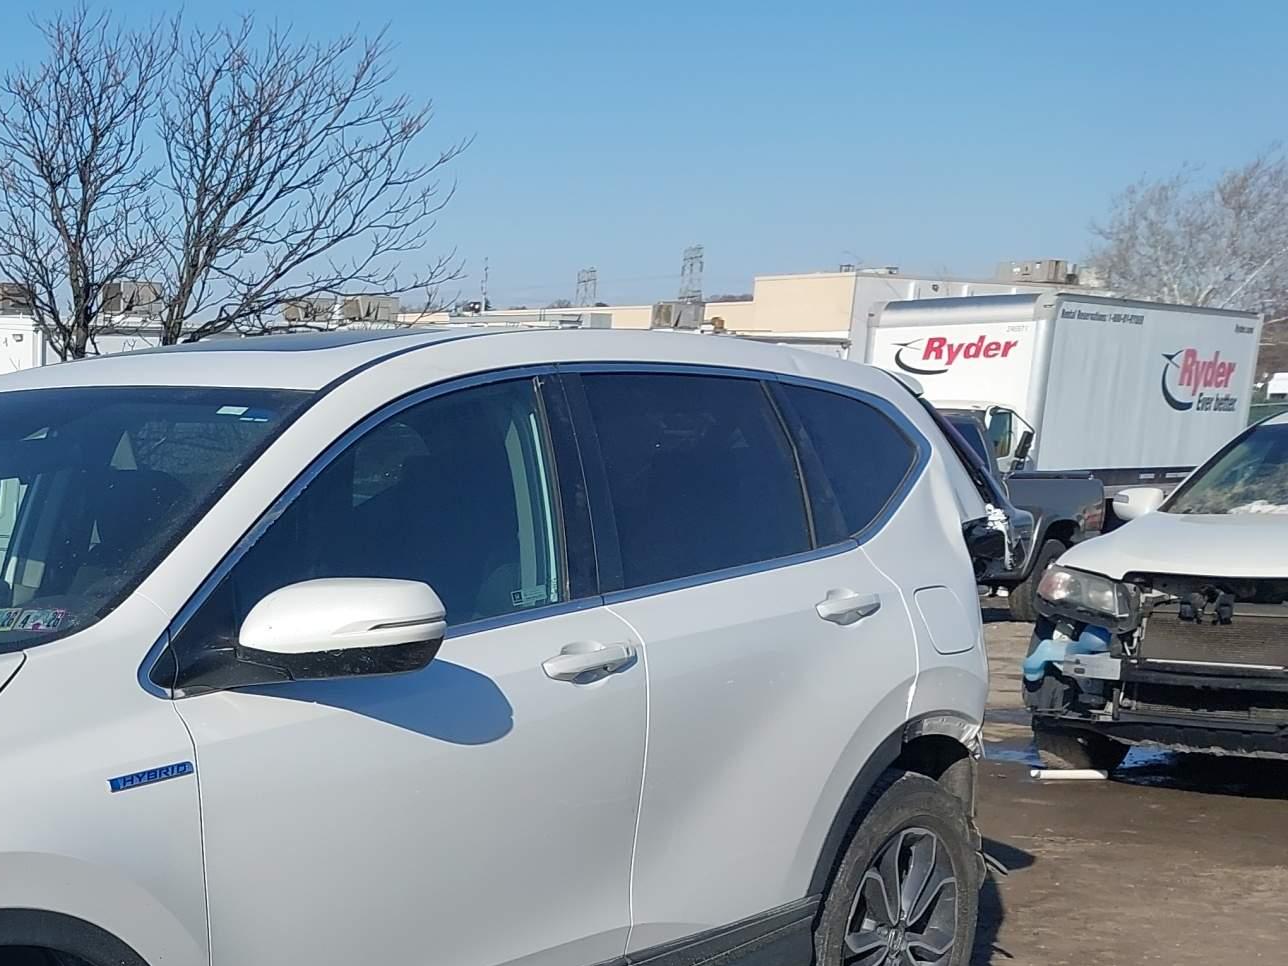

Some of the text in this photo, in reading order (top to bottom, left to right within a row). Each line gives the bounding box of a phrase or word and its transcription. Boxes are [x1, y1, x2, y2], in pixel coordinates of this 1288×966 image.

[922, 334, 1018, 366] Ryder
[1178, 348, 1237, 396] Ryder
[1196, 392, 1214, 411] Ever
[119, 763, 192, 790] HYBRID
